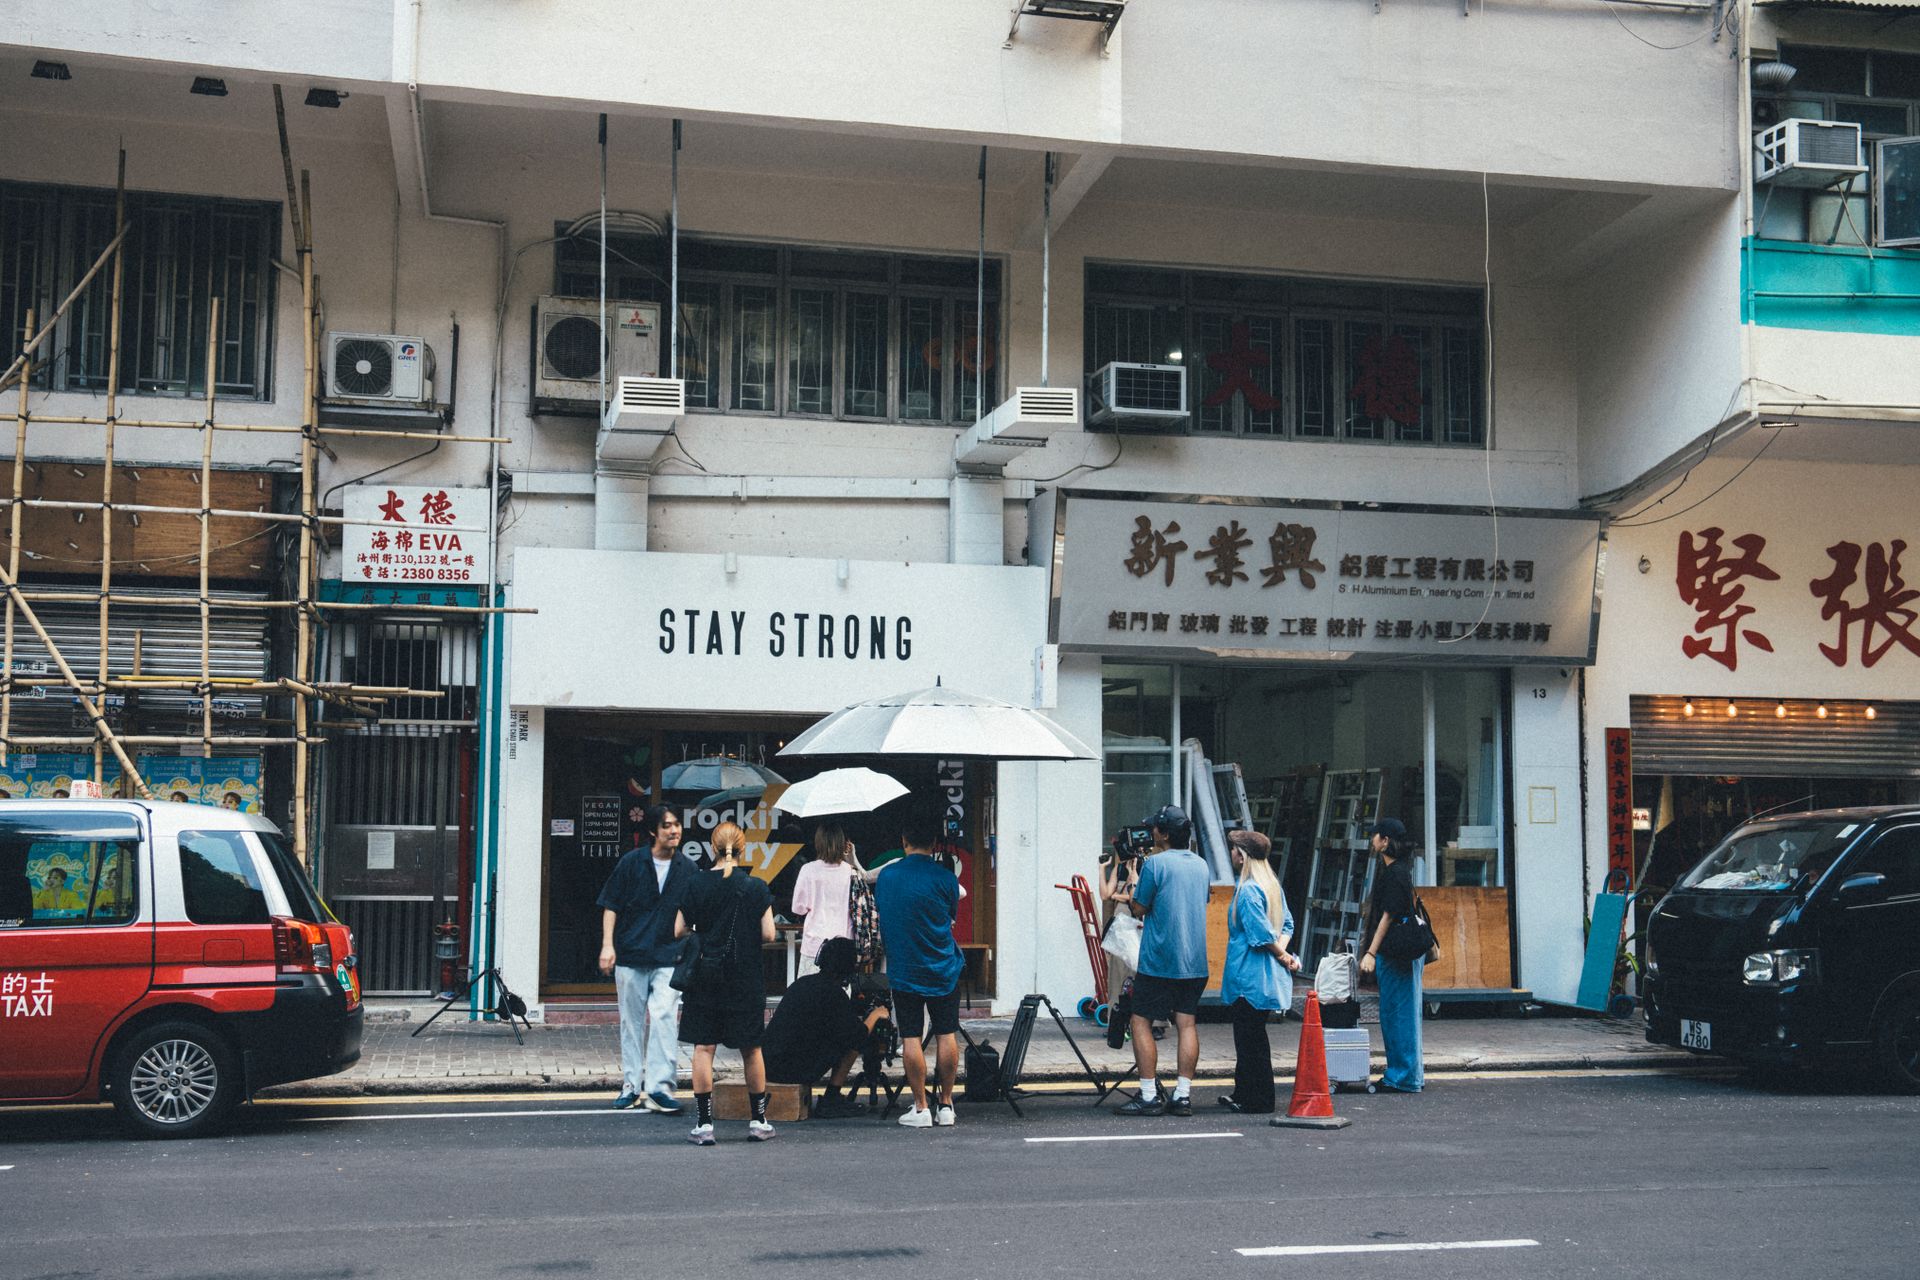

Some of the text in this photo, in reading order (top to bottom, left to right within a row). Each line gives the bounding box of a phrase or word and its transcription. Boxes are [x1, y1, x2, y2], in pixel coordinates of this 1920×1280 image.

[377, 490, 457, 525] 大德
[371, 530, 463, 552] 海棉 EVA
[1123, 514, 1327, 590] 新業興
[401, 567, 434, 580] 2380
[437, 568, 470, 581] 8356
[1338, 552, 1535, 583] 鋁質工程有限公司
[1362, 585, 1408, 596] Aluminium
[659, 607, 912, 661] STAY STRONG
[1179, 612, 1221, 634] 玻璃
[1228, 614, 1270, 636] 批發
[1279, 617, 1317, 637] 工程
[1327, 617, 1366, 638] 設計
[1531, 688, 1547, 699] 13
[519, 710, 529, 742] THE PARK
[581, 844, 620, 857] YEARS
[682, 840, 780, 870] evry
[2, 972, 55, 994] 的士
[0, 994, 53, 1018] TAXI
[1689, 1020, 1702, 1035] WS
[1683, 1033, 1709, 1049] 4780
